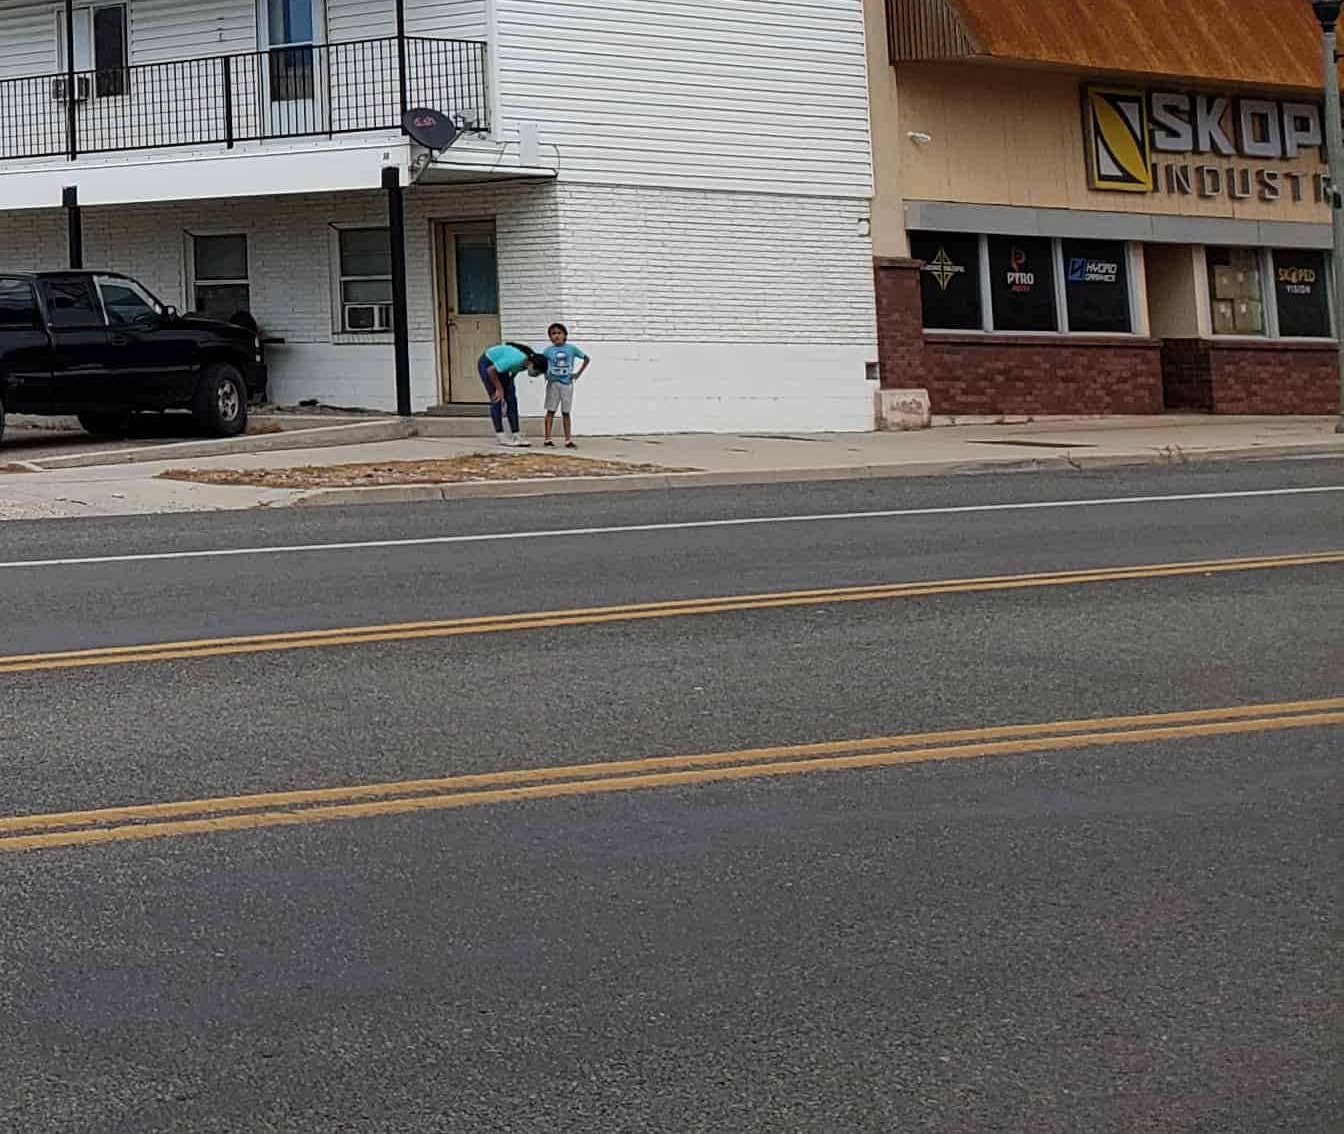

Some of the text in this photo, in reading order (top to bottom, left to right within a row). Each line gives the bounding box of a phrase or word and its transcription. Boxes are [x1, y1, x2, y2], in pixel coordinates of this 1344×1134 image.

[1149, 91, 1326, 159] SKOP
[1087, 261, 1117, 274] HYDRO
[1006, 271, 1035, 284] PYRO
